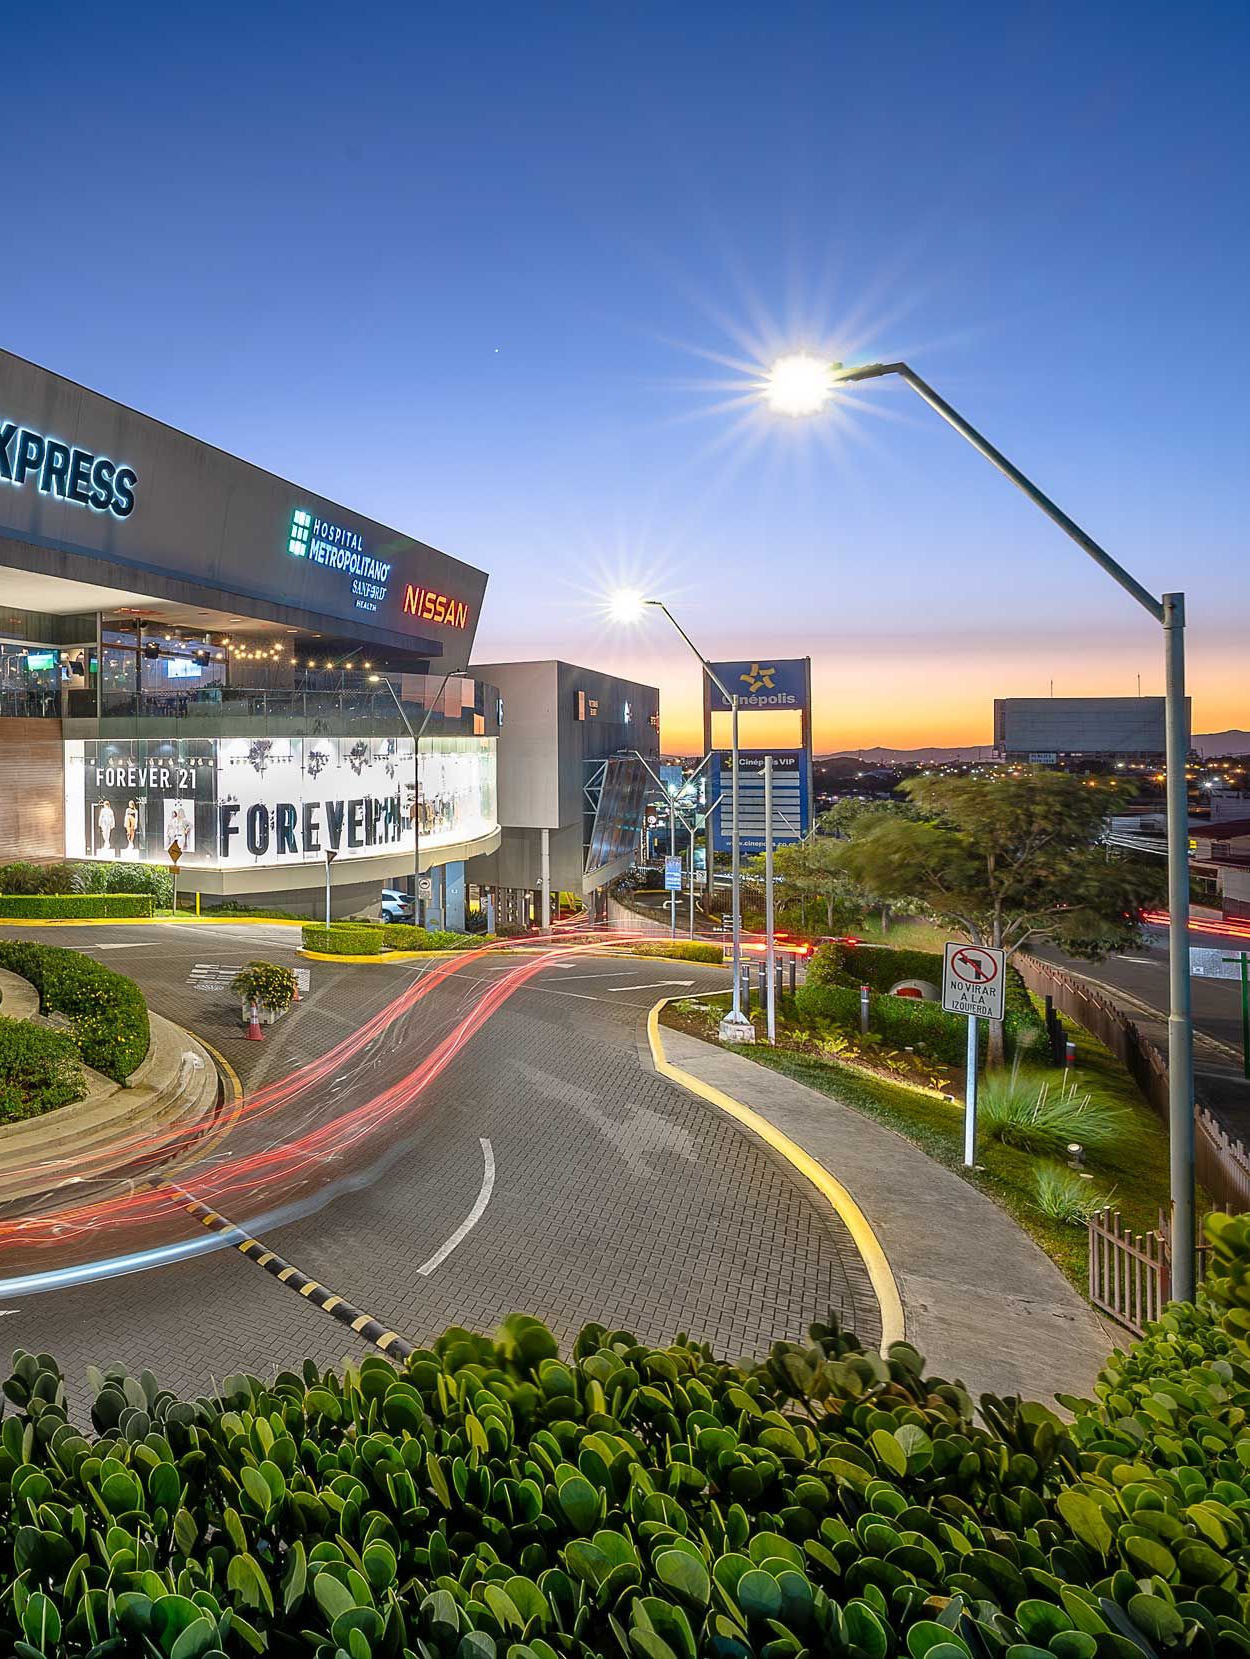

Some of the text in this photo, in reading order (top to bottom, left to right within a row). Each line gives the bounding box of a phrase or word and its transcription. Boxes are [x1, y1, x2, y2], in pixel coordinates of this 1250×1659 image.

[312, 517, 363, 552] HOSPITAL
[308, 537, 390, 583] METROPOLITANO
[352, 579, 387, 601] SANFORD
[356, 599, 377, 612] HEALTH
[403, 583, 469, 630] NISSAN
[779, 758, 796, 767] VIP
[96, 767, 196, 789] FOREVER 21
[950, 981, 996, 997] NO VIRAR
[960, 992, 986, 1005] A LA
[952, 1001, 993, 1016] IZQUIERDA
